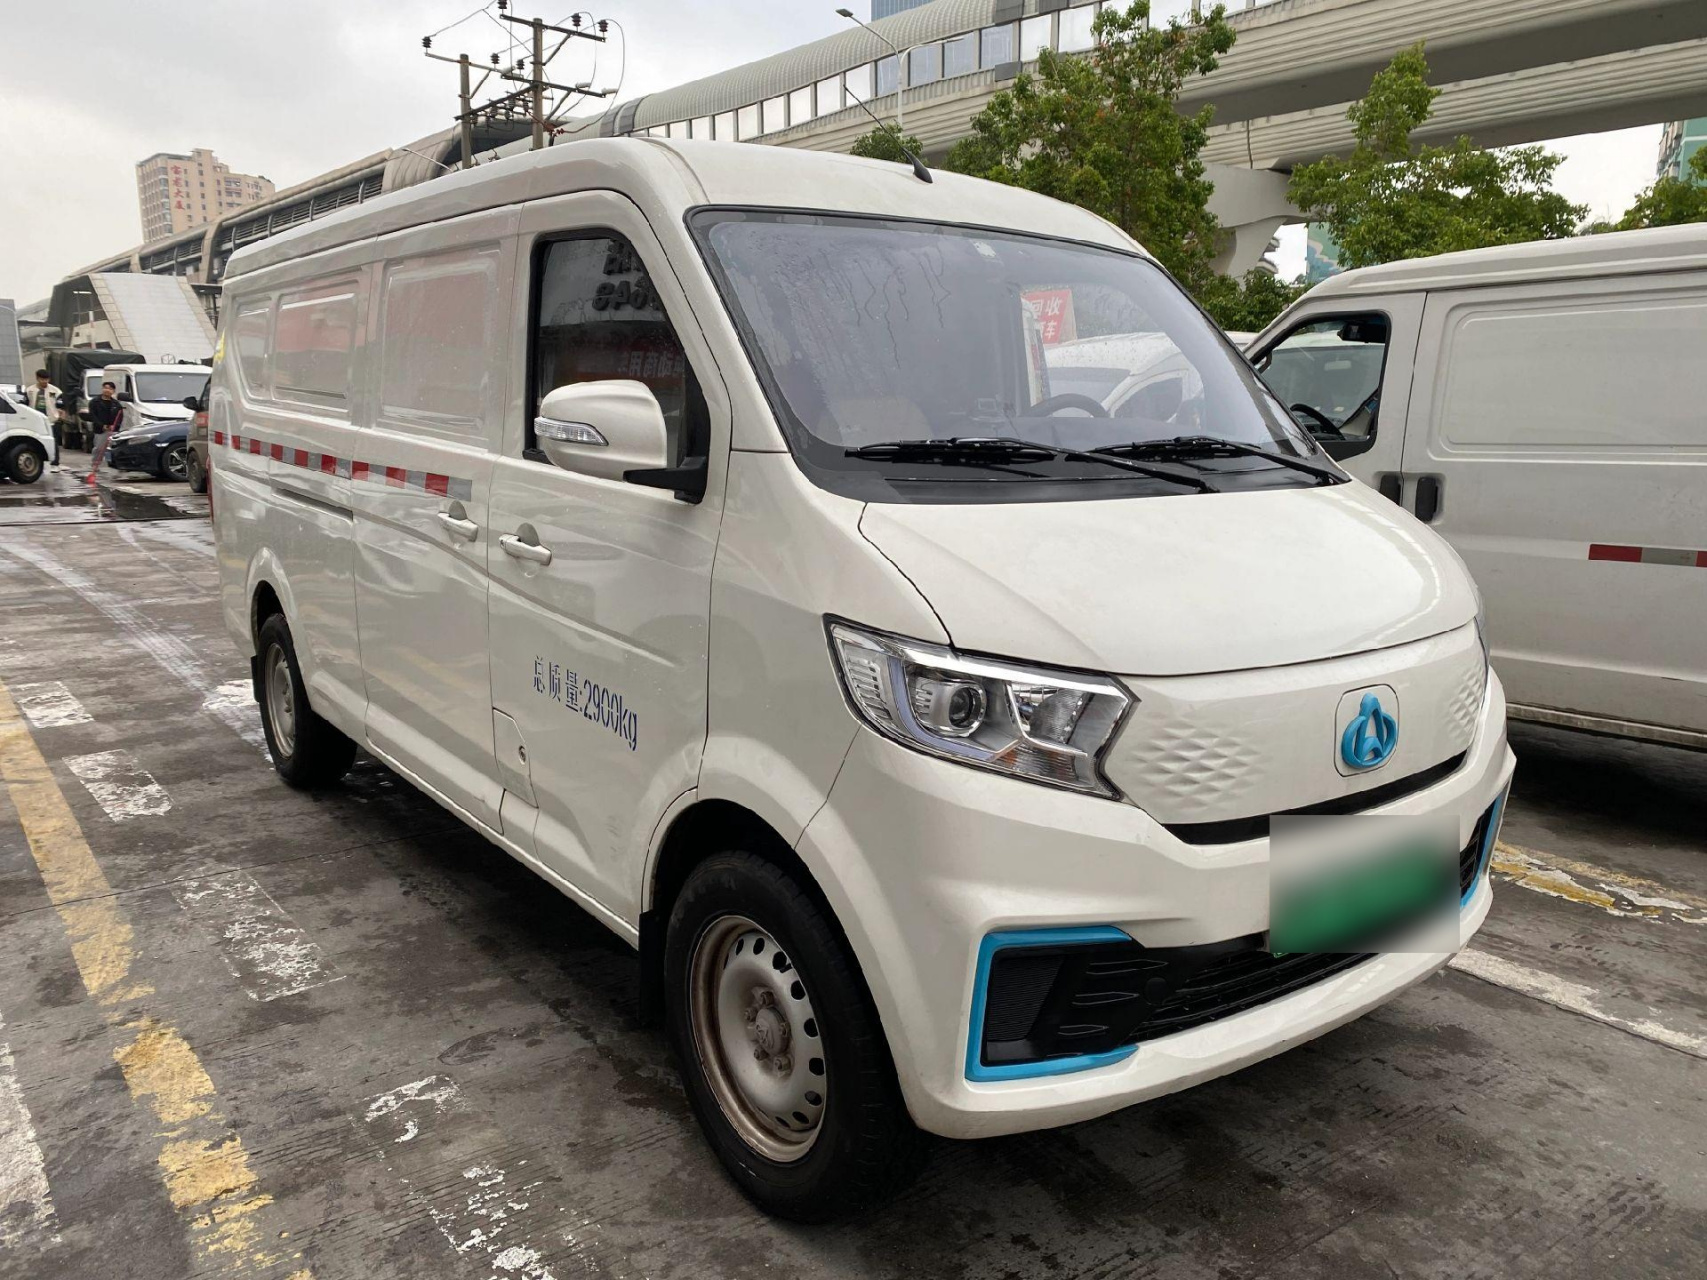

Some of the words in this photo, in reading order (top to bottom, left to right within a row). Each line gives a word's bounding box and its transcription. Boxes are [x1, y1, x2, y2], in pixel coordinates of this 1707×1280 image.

[1031, 297, 1063, 316] 回收
[533, 654, 638, 752] 总质量:2900kg
